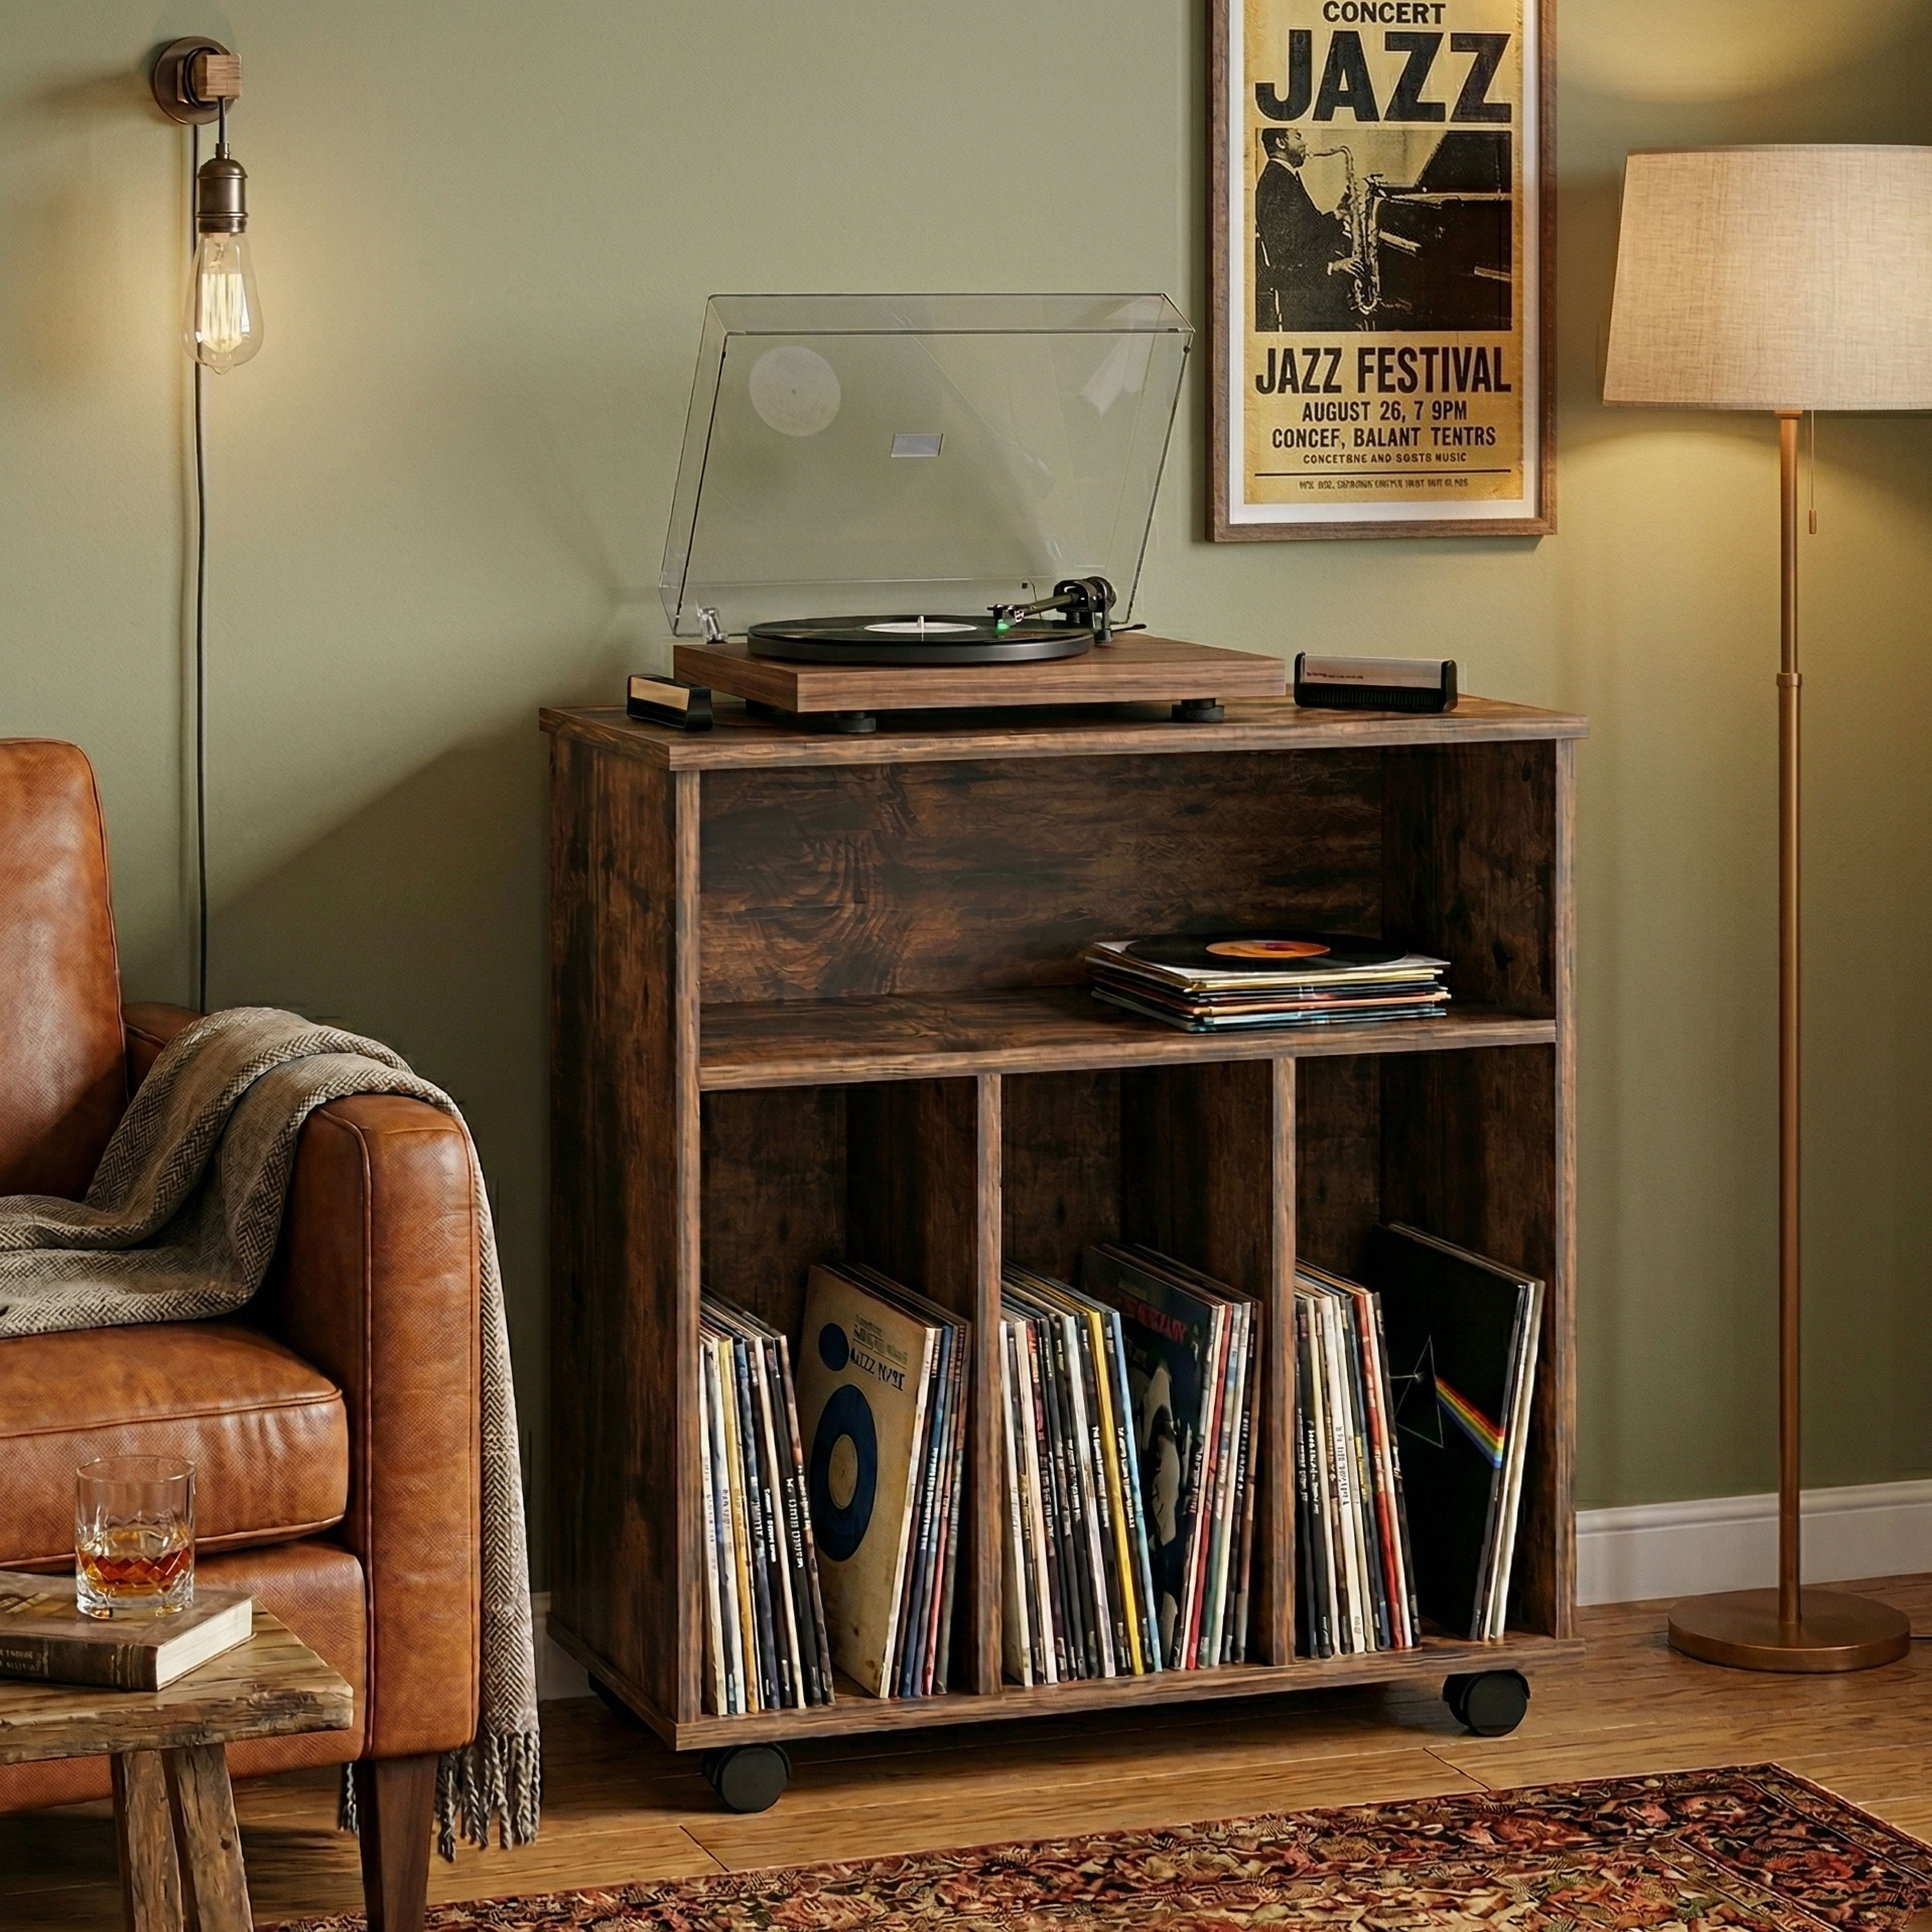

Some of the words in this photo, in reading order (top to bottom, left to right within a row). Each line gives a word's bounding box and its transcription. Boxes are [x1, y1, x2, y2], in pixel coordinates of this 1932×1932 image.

[1323, 1, 1446, 24] CONCERT
[1255, 29, 1512, 124] JAZZ
[1255, 347, 1342, 395] JAZZ
[1357, 346, 1512, 393] FESTIVAL
[1302, 401, 1371, 422] AUGUST
[1380, 400, 1406, 424] 26,
[1413, 400, 1424, 421] 7
[1431, 400, 1468, 421] 9PM
[1272, 428, 1345, 450] CONCEF,
[1353, 427, 1422, 447] BALANT
[1430, 426, 1496, 447] TENTRS
[1371, 453, 1393, 464] AND
